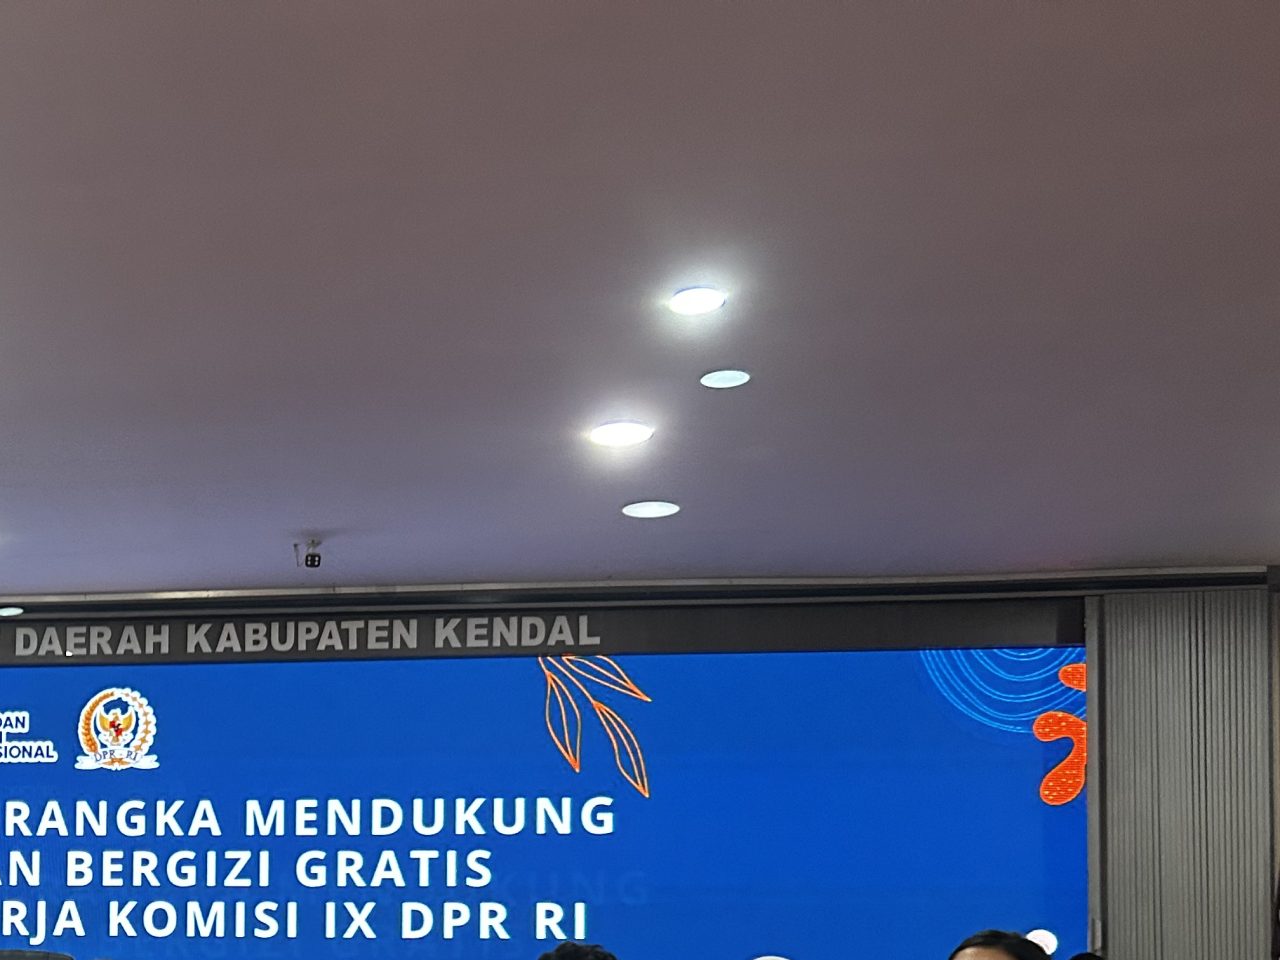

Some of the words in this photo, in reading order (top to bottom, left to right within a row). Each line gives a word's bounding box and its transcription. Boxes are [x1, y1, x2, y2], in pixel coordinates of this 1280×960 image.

[14, 624, 170, 658] DAERAH
[186, 618, 418, 654] KABUPATEN
[434, 614, 602, 648] KENDAL
[5, 799, 222, 836] RANGKA
[245, 796, 616, 836] MENDUKUNG
[66, 850, 269, 887] BERGIZI
[296, 849, 493, 887] GRATIS
[108, 900, 298, 938] KOMISI
[325, 901, 376, 938] IX
[401, 901, 510, 939] DPR
[535, 902, 586, 939] RI
